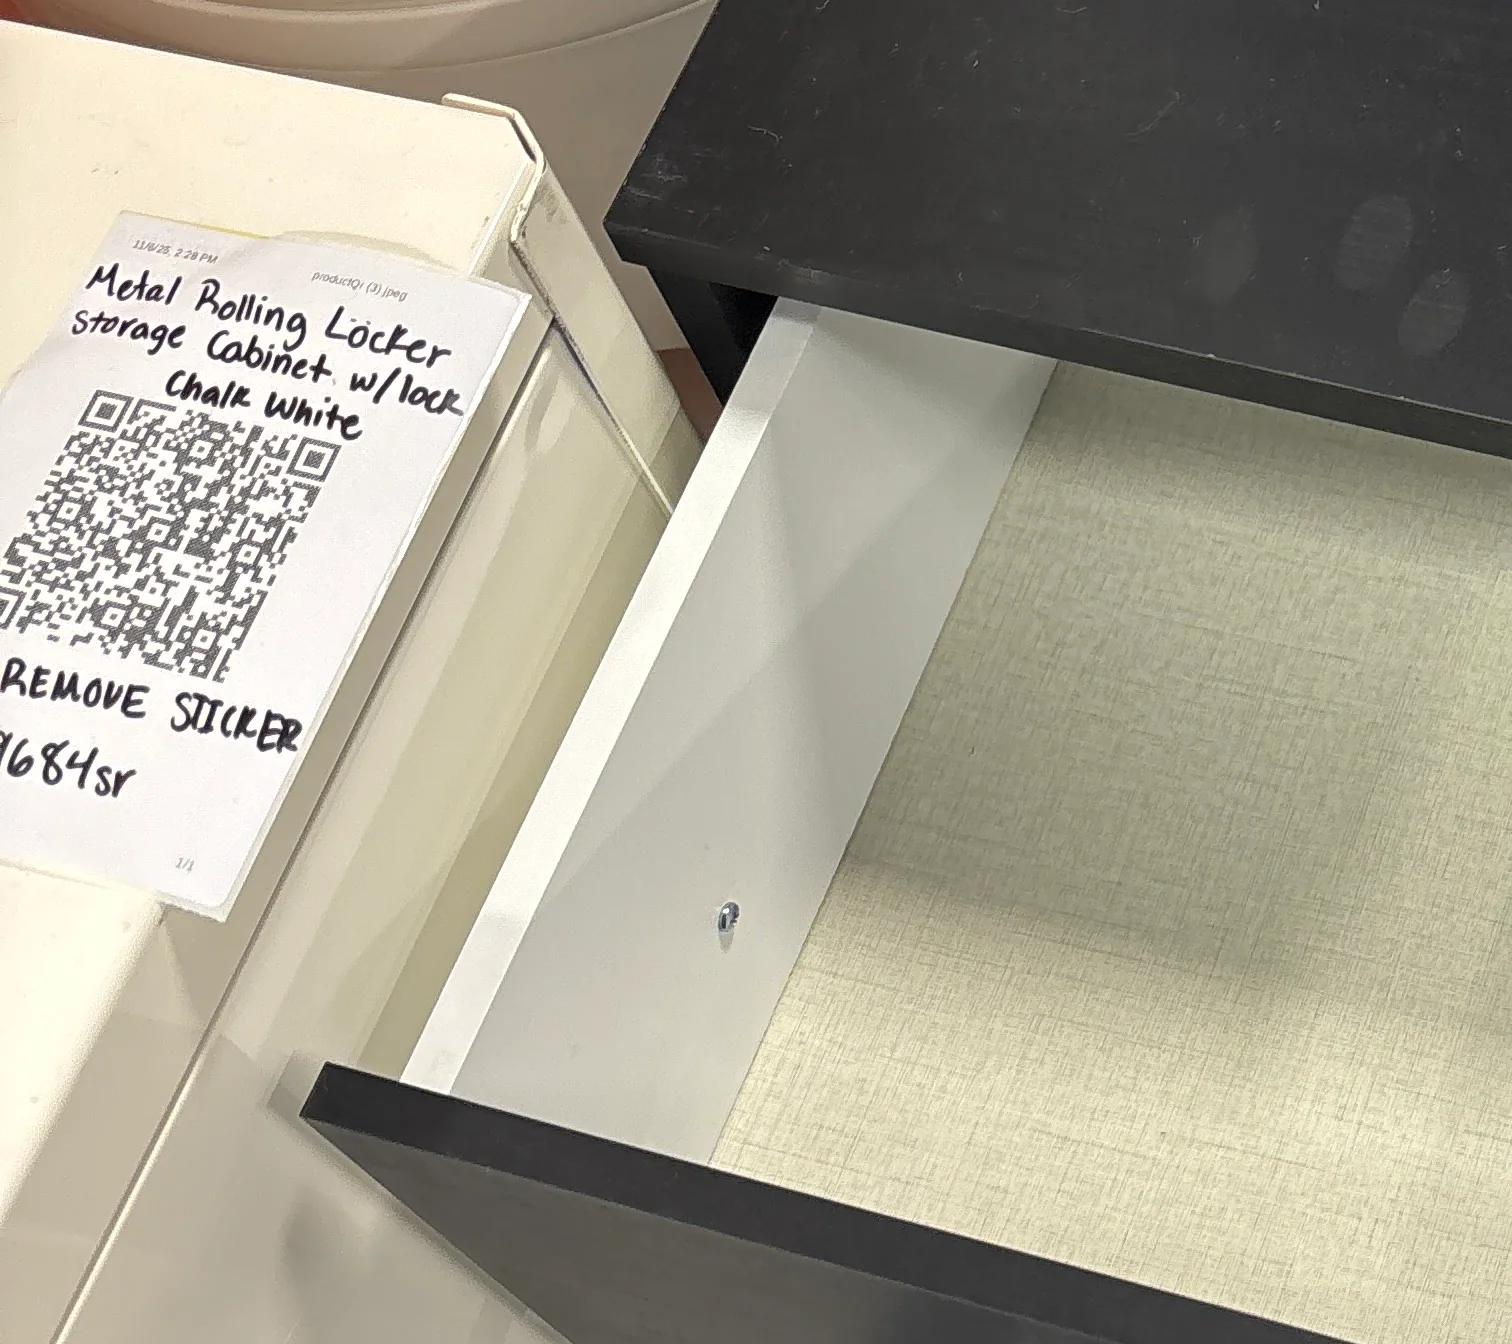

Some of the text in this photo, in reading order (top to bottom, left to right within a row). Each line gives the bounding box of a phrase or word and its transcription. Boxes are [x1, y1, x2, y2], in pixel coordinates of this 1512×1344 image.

[198, 252, 219, 265] PM
[84, 262, 184, 306] Metal
[193, 278, 308, 352] Rolling
[164, 369, 252, 410] Chalk
[207, 329, 334, 383] Cabinet
[349, 367, 464, 417] w/lock
[0, 657, 303, 754] REMOVE STICKER
[174, 856, 196, 873] 1/1
